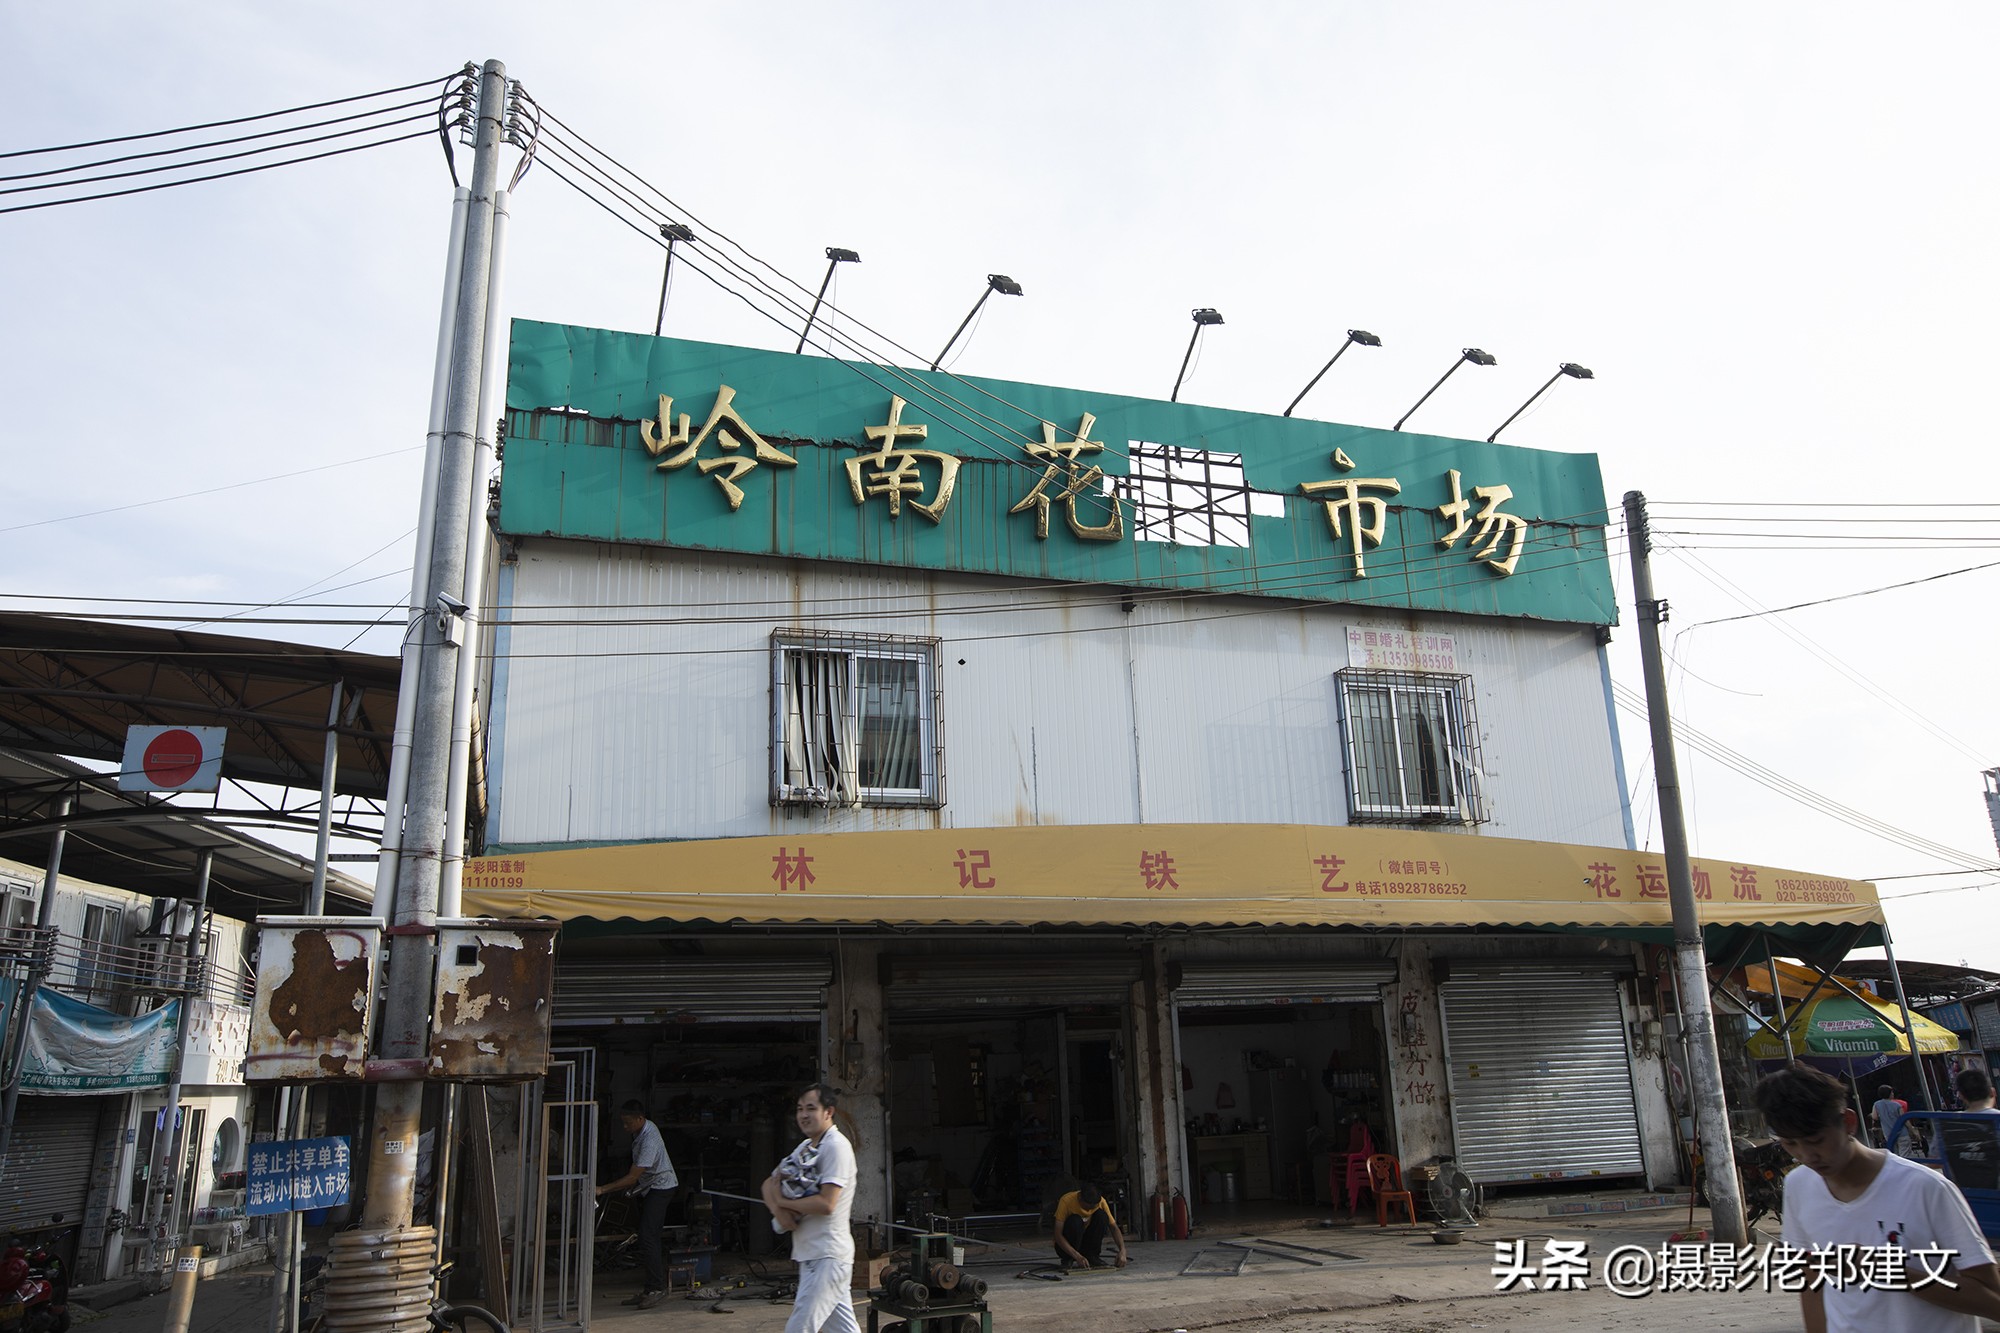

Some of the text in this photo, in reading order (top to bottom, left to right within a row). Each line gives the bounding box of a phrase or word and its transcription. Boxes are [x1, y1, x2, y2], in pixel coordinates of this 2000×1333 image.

[1349, 630, 1453, 652] 中国婚礼培训网
[1351, 648, 1454, 670] 话:13539985508
[772, 847, 1349, 892] 林记铁艺
[1775, 879, 1850, 892] 18620636002
[1824, 1038, 1880, 1052] Vitamin
[252, 1144, 348, 1176] 禁止共享单车
[250, 1171, 347, 1205] 流动小贩进入市场
